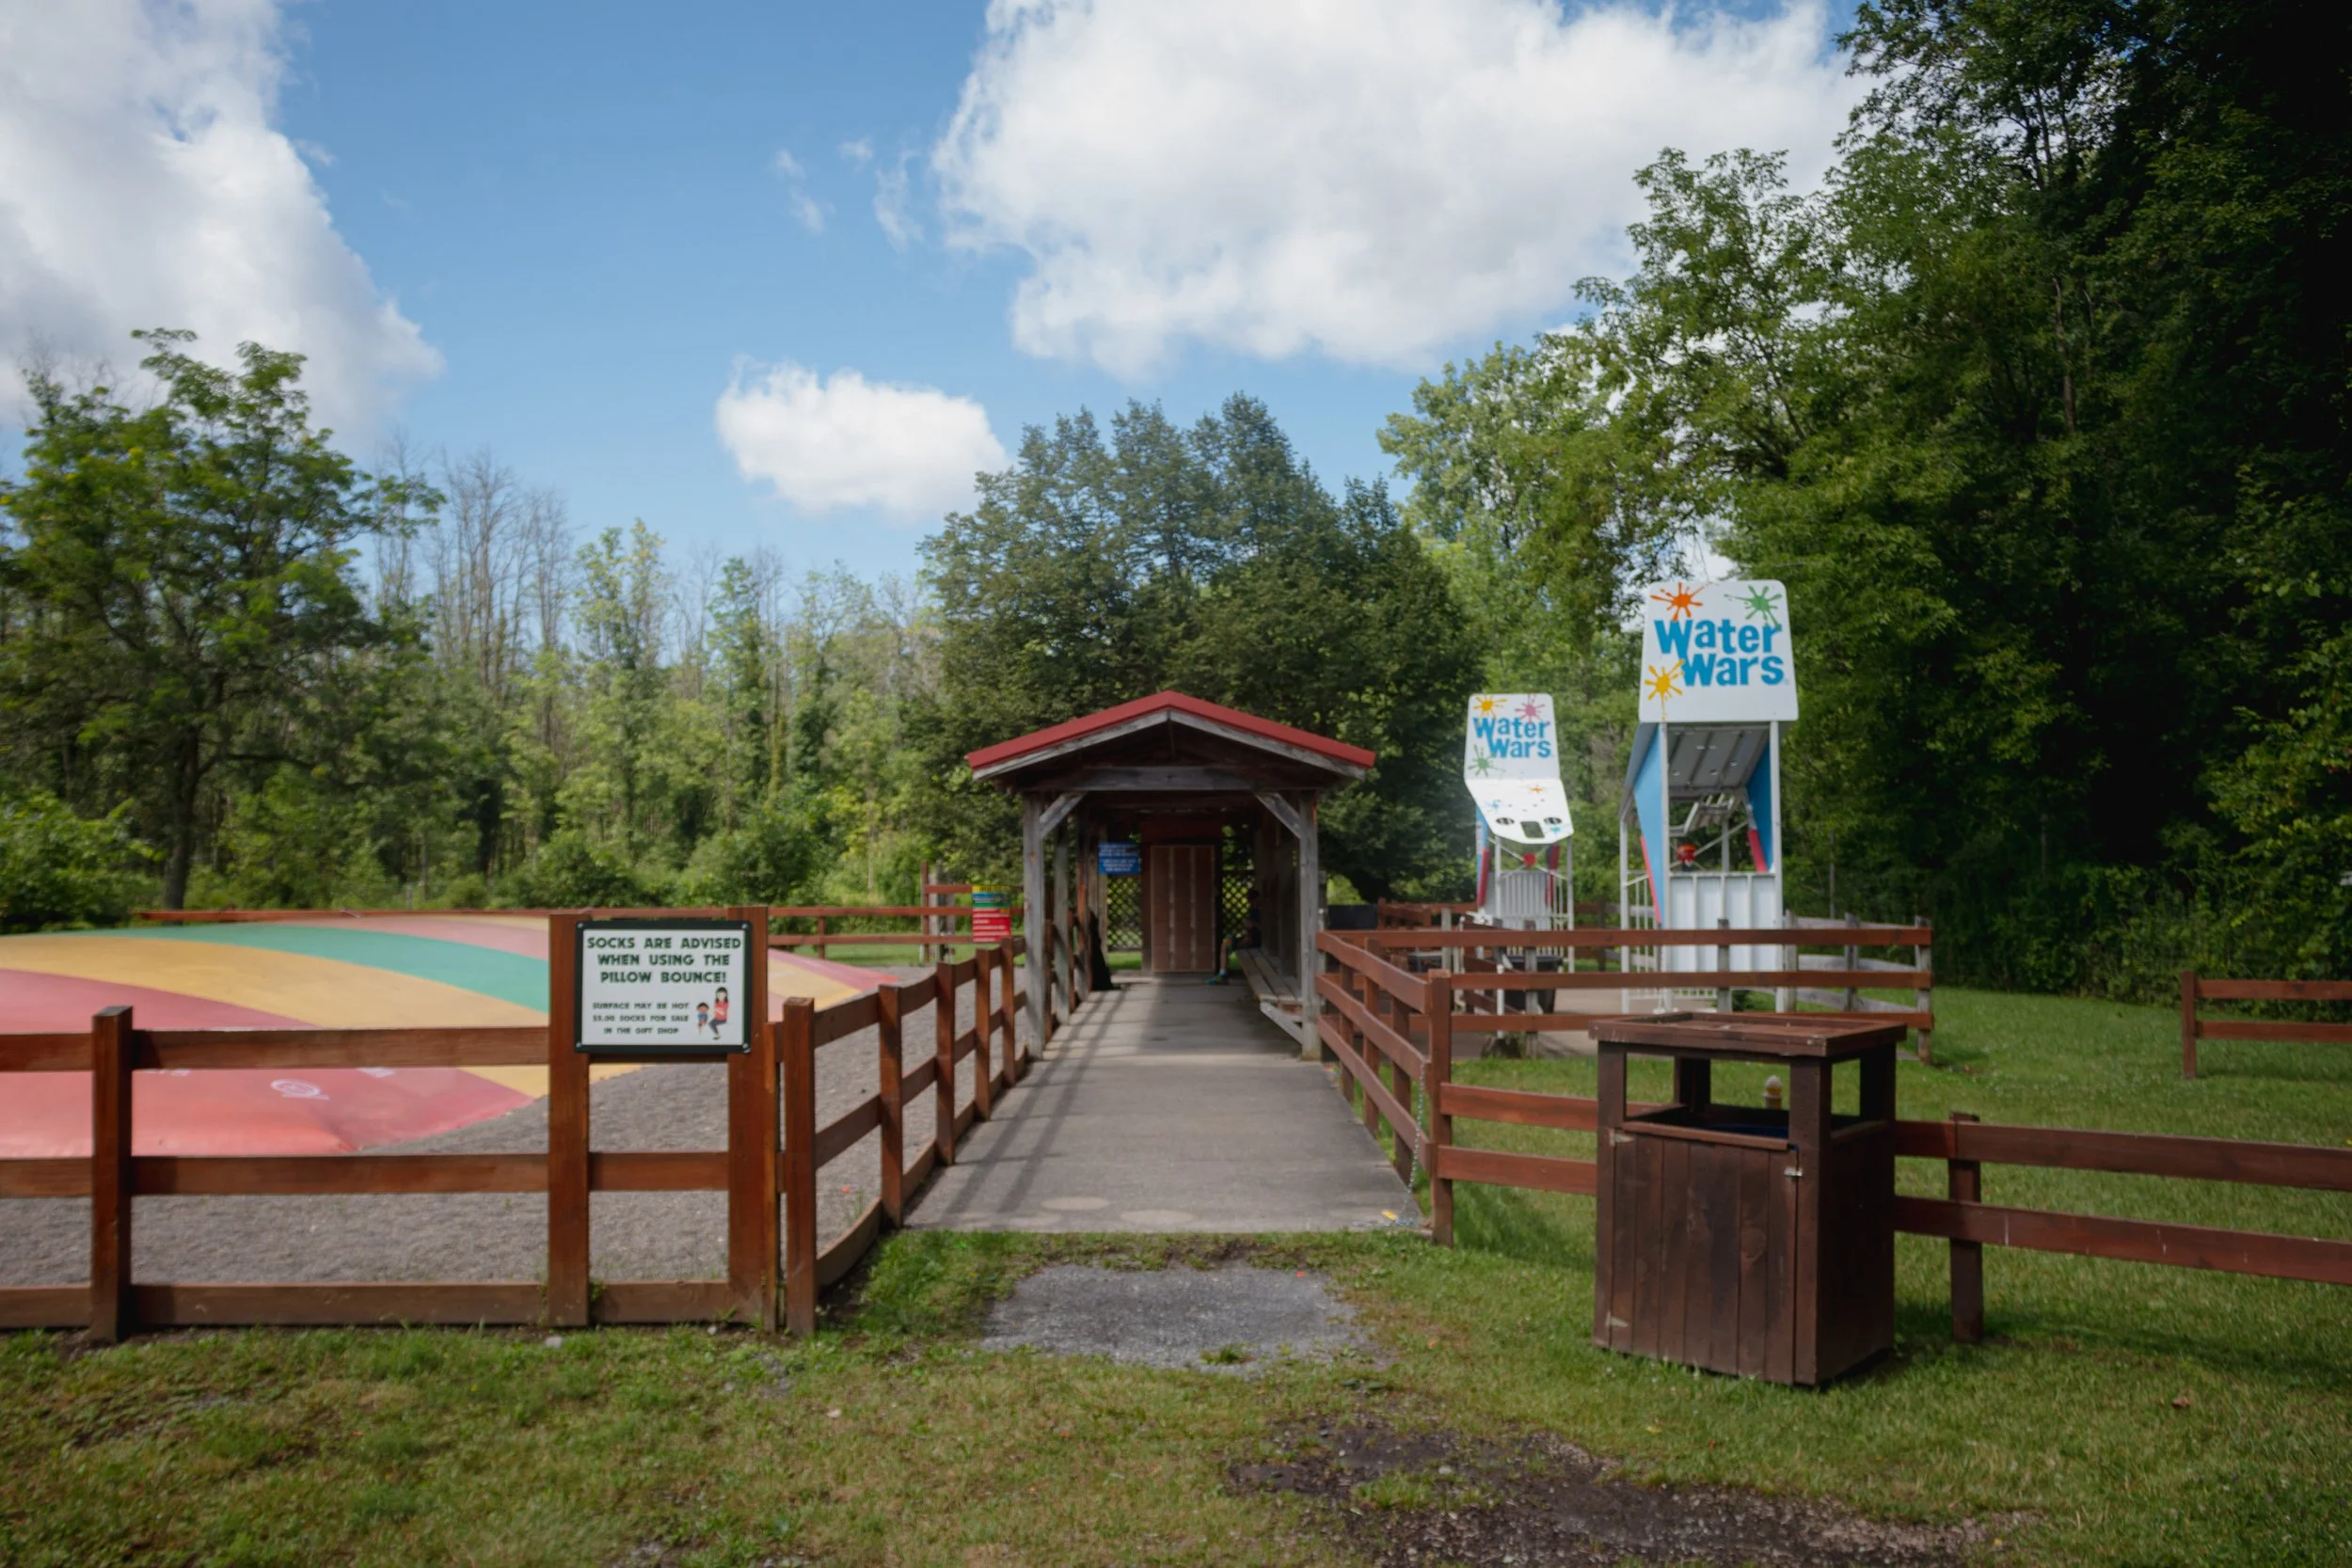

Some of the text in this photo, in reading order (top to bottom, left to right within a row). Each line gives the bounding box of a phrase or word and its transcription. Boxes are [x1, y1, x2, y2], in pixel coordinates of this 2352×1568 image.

[1653, 619, 1783, 655] Water
[1680, 653, 1785, 687] Wars
[1473, 717, 1551, 739] Water
[1490, 738, 1551, 758] Wars
[587, 937, 741, 950] SOCKS ARE ADVISED
[597, 954, 731, 966] WHEN USING THE
[600, 972, 727, 984] PILLOW BOUNCE!
